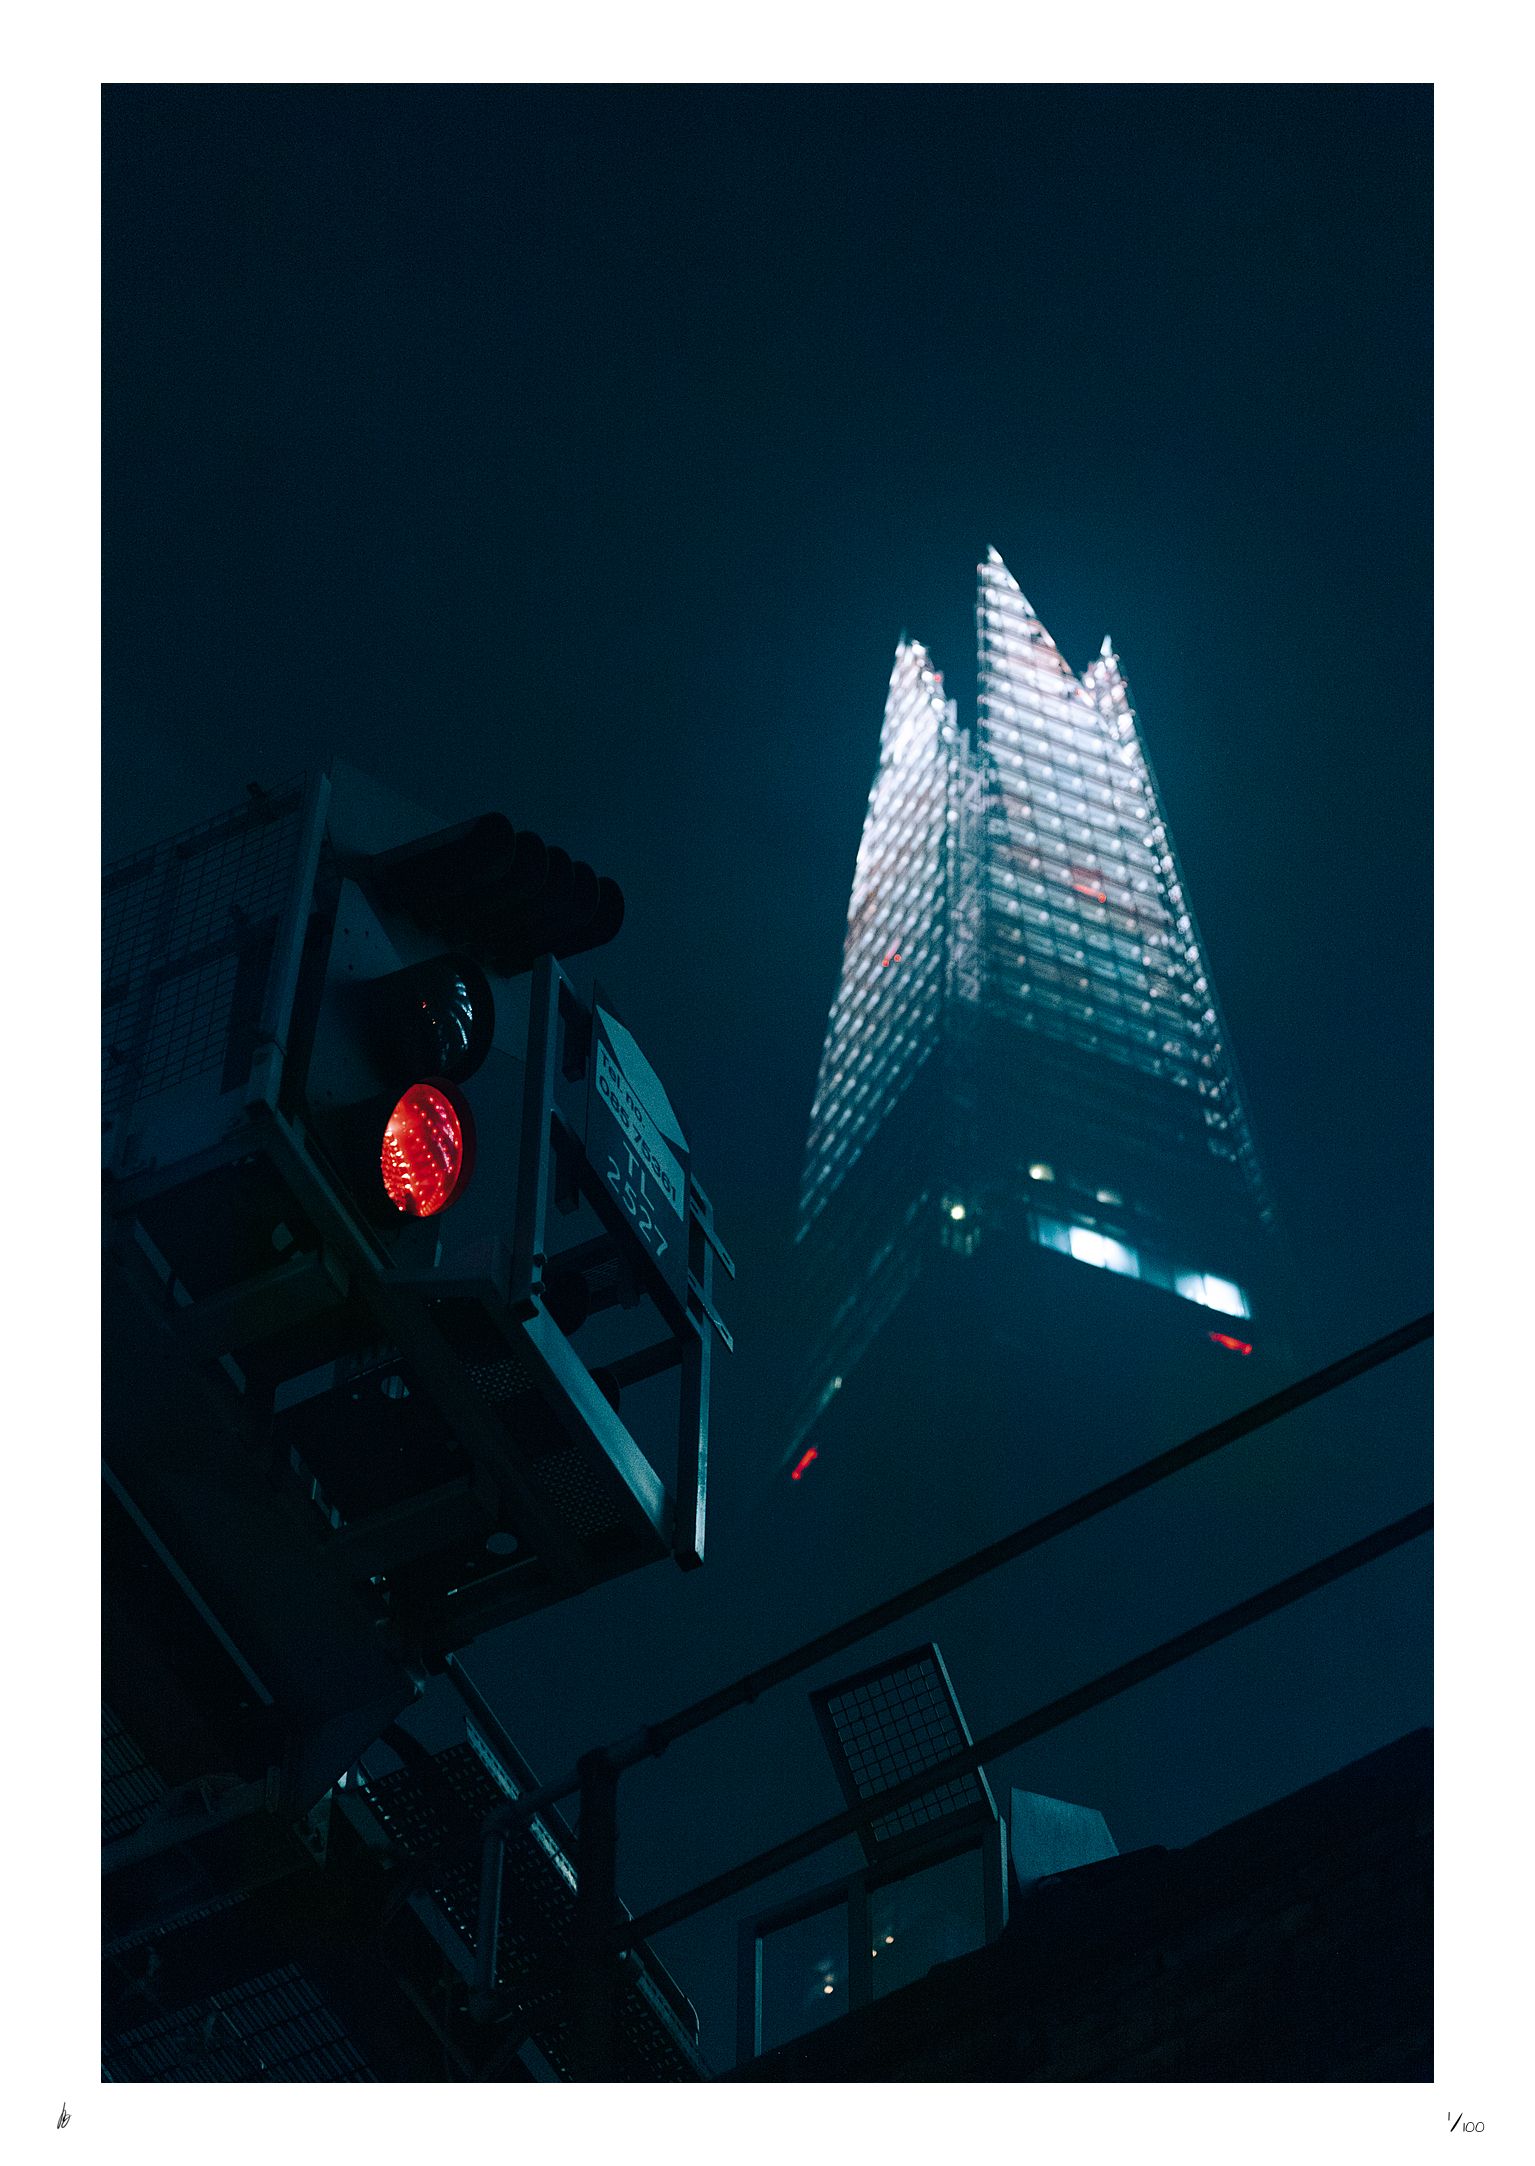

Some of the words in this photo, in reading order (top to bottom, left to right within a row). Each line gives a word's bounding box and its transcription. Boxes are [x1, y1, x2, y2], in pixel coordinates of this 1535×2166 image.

[626, 1092, 646, 1130] no.
[607, 1155, 668, 1256] 2527
[623, 1140, 654, 1211] TL
